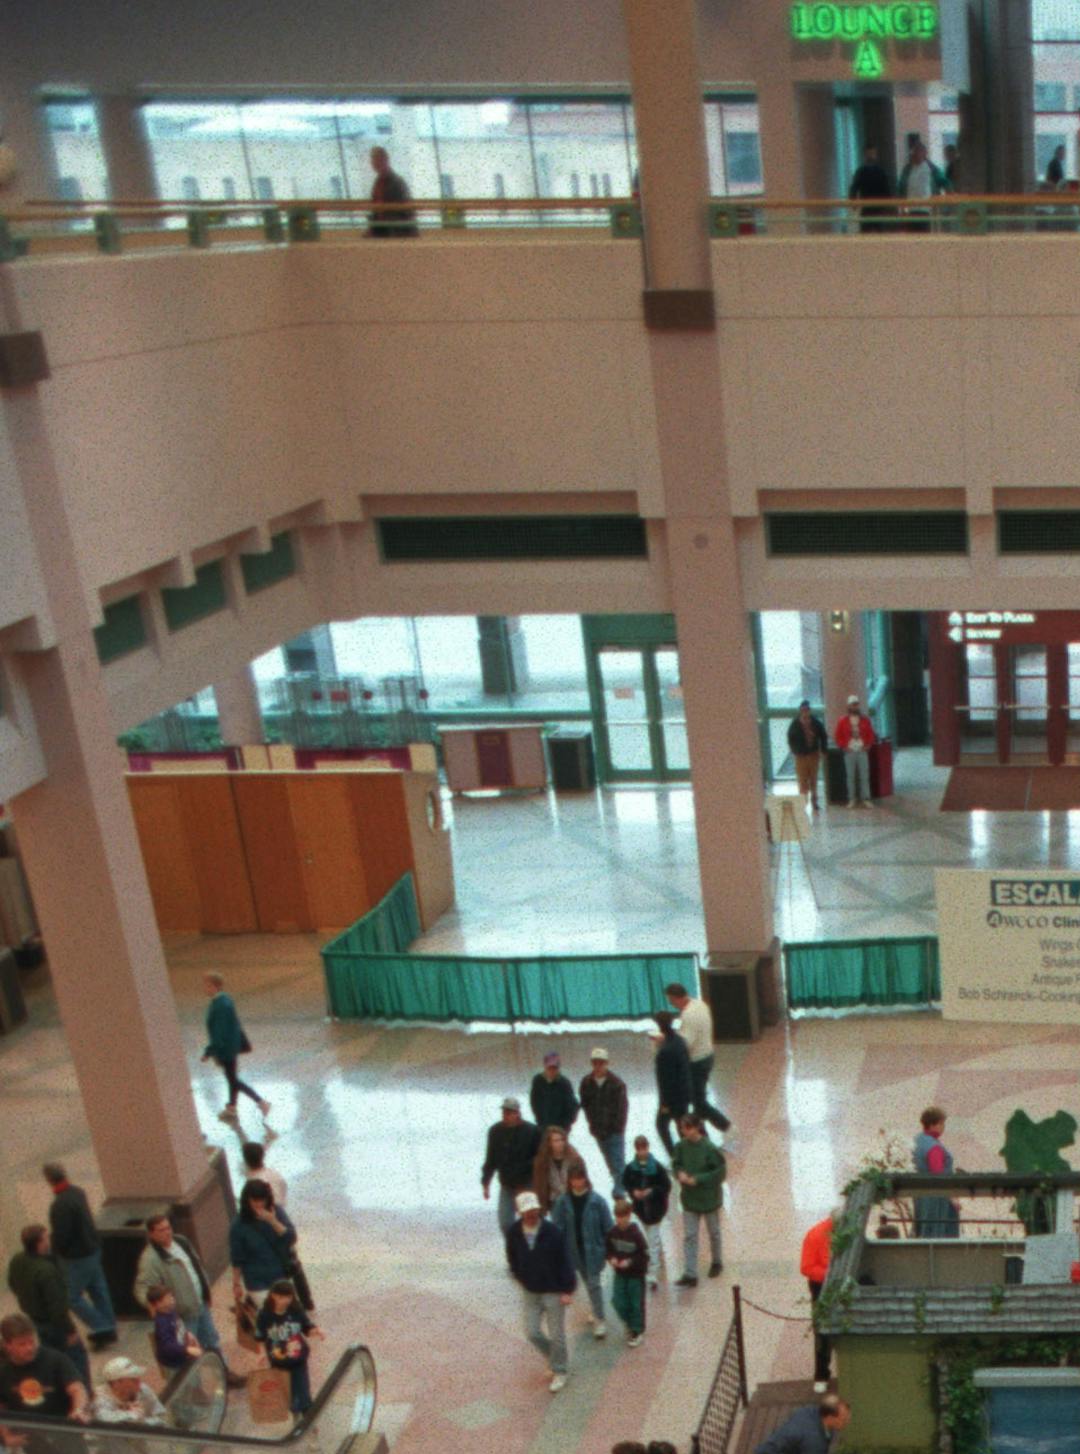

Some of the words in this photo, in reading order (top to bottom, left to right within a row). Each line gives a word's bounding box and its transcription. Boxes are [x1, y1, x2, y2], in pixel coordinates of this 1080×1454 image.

[790, 3, 936, 40] LOUNGE
[853, 39, 883, 78] A
[958, 987, 980, 1000] Bob
